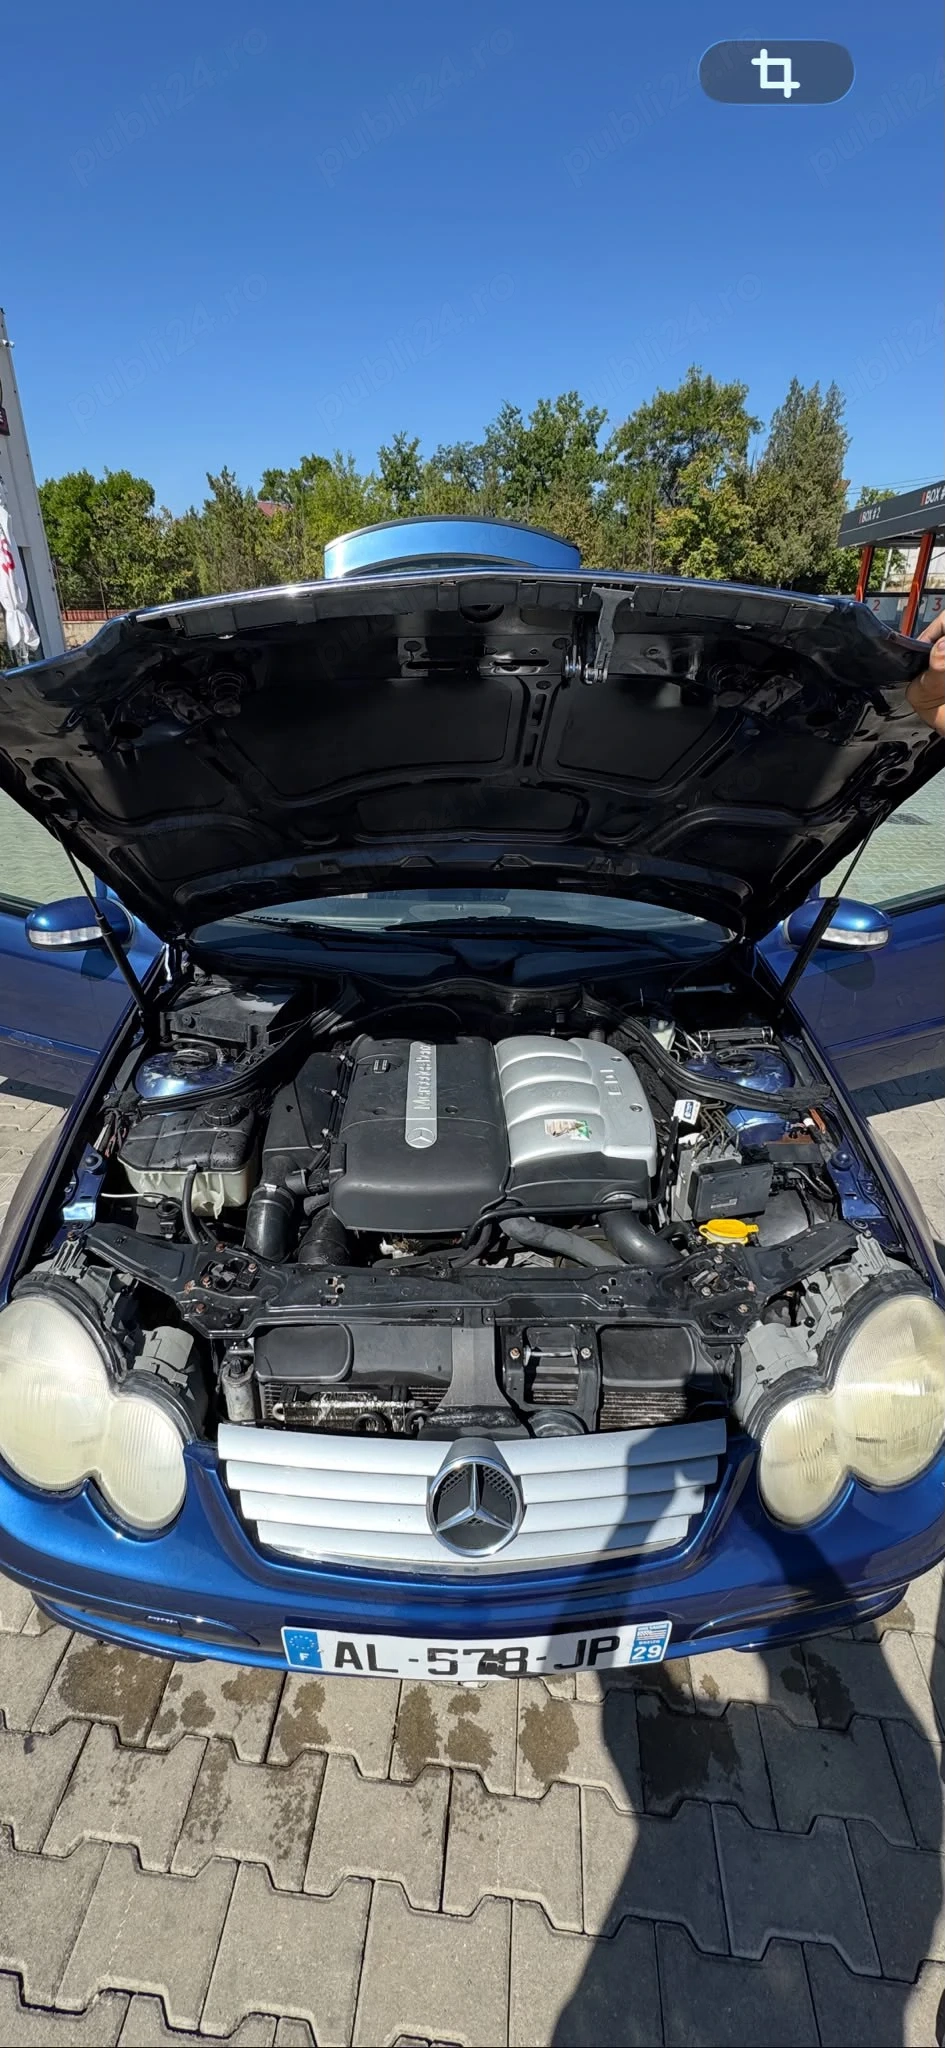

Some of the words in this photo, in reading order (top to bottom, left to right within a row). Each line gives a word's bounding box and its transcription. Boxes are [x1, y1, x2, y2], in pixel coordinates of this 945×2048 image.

[872, 599, 881, 612] 2
[932, 597, 943, 612] 3
[299, 1652, 309, 1661] F
[631, 1644, 662, 1661] 29
